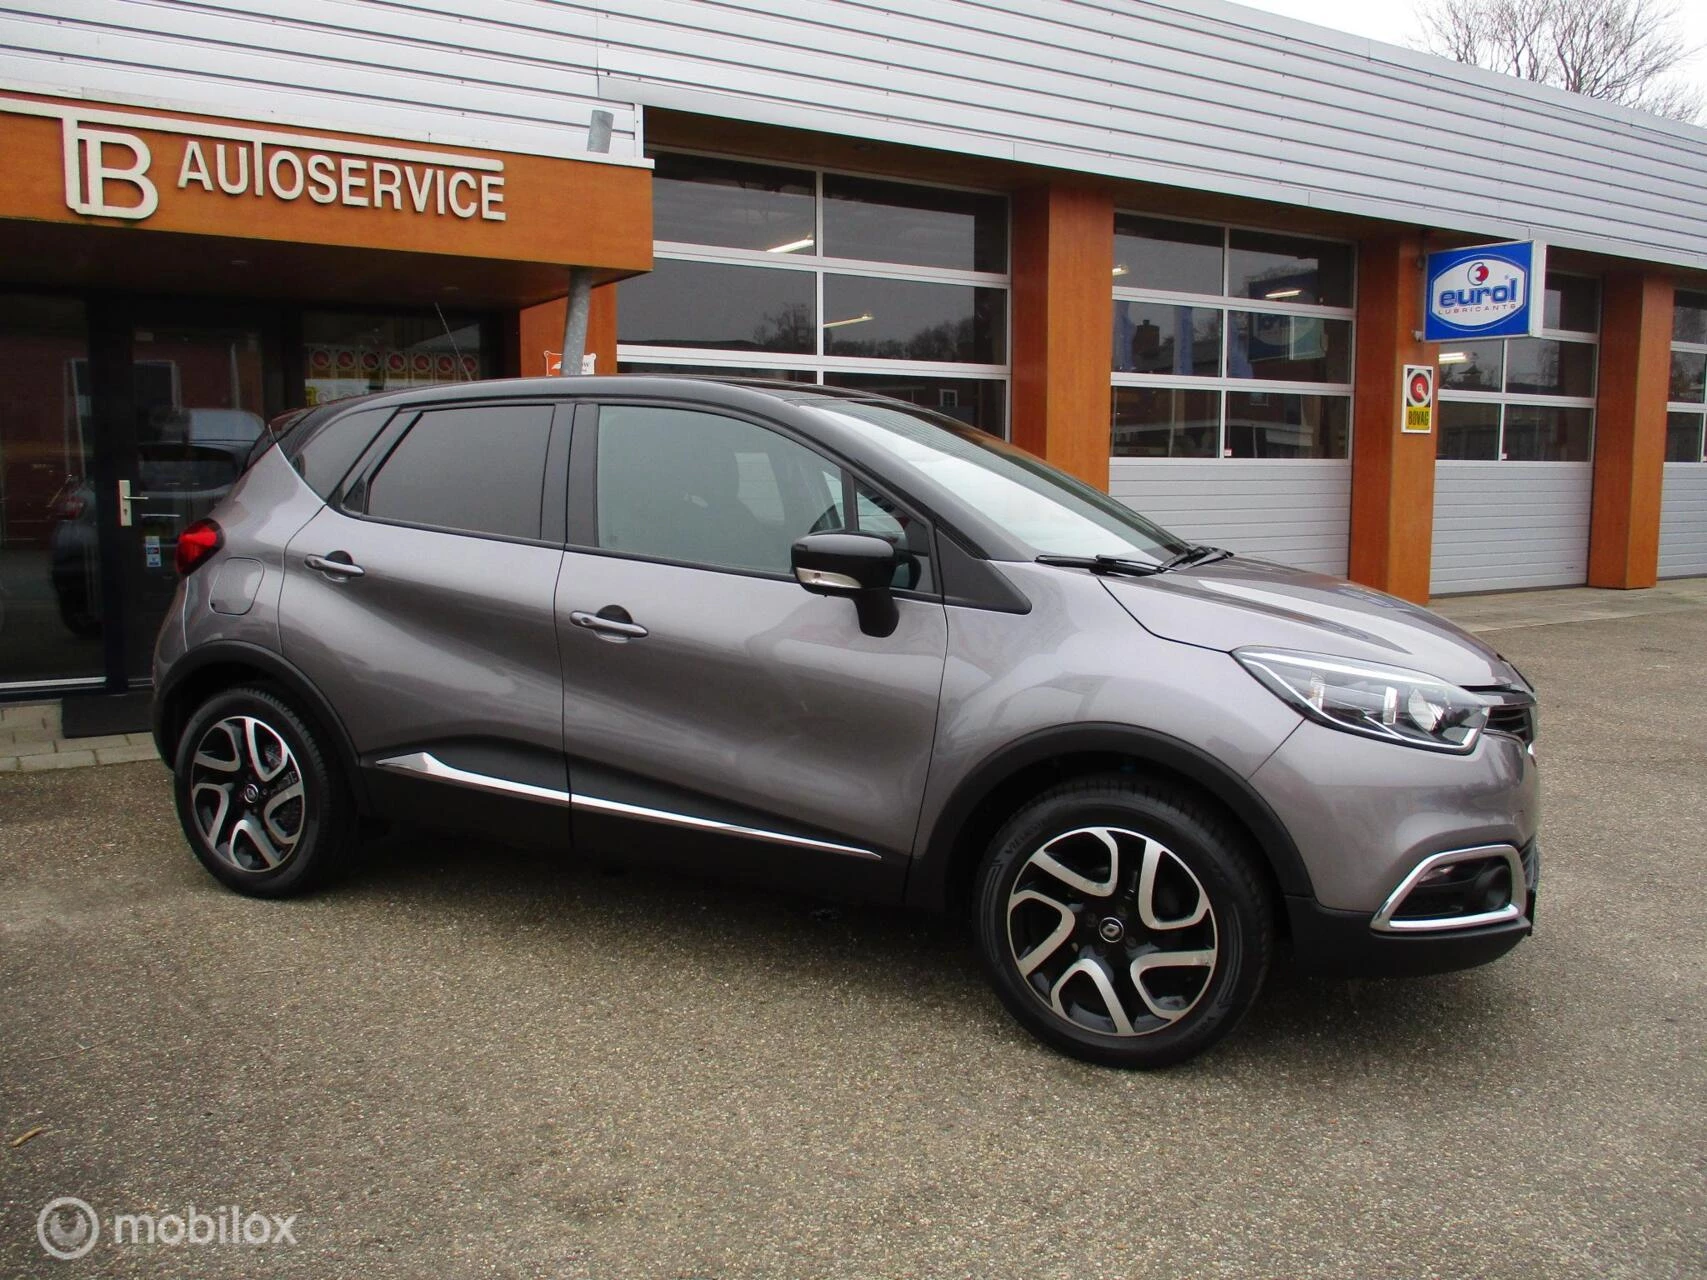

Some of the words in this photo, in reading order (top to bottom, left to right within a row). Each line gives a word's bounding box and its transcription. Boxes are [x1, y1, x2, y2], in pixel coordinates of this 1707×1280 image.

[177, 140, 506, 221] AUTOSERVICE
[1439, 277, 1517, 308] eurol
[1438, 303, 1516, 315] LUBRICANTS
[1408, 410, 1429, 426] BOVAG
